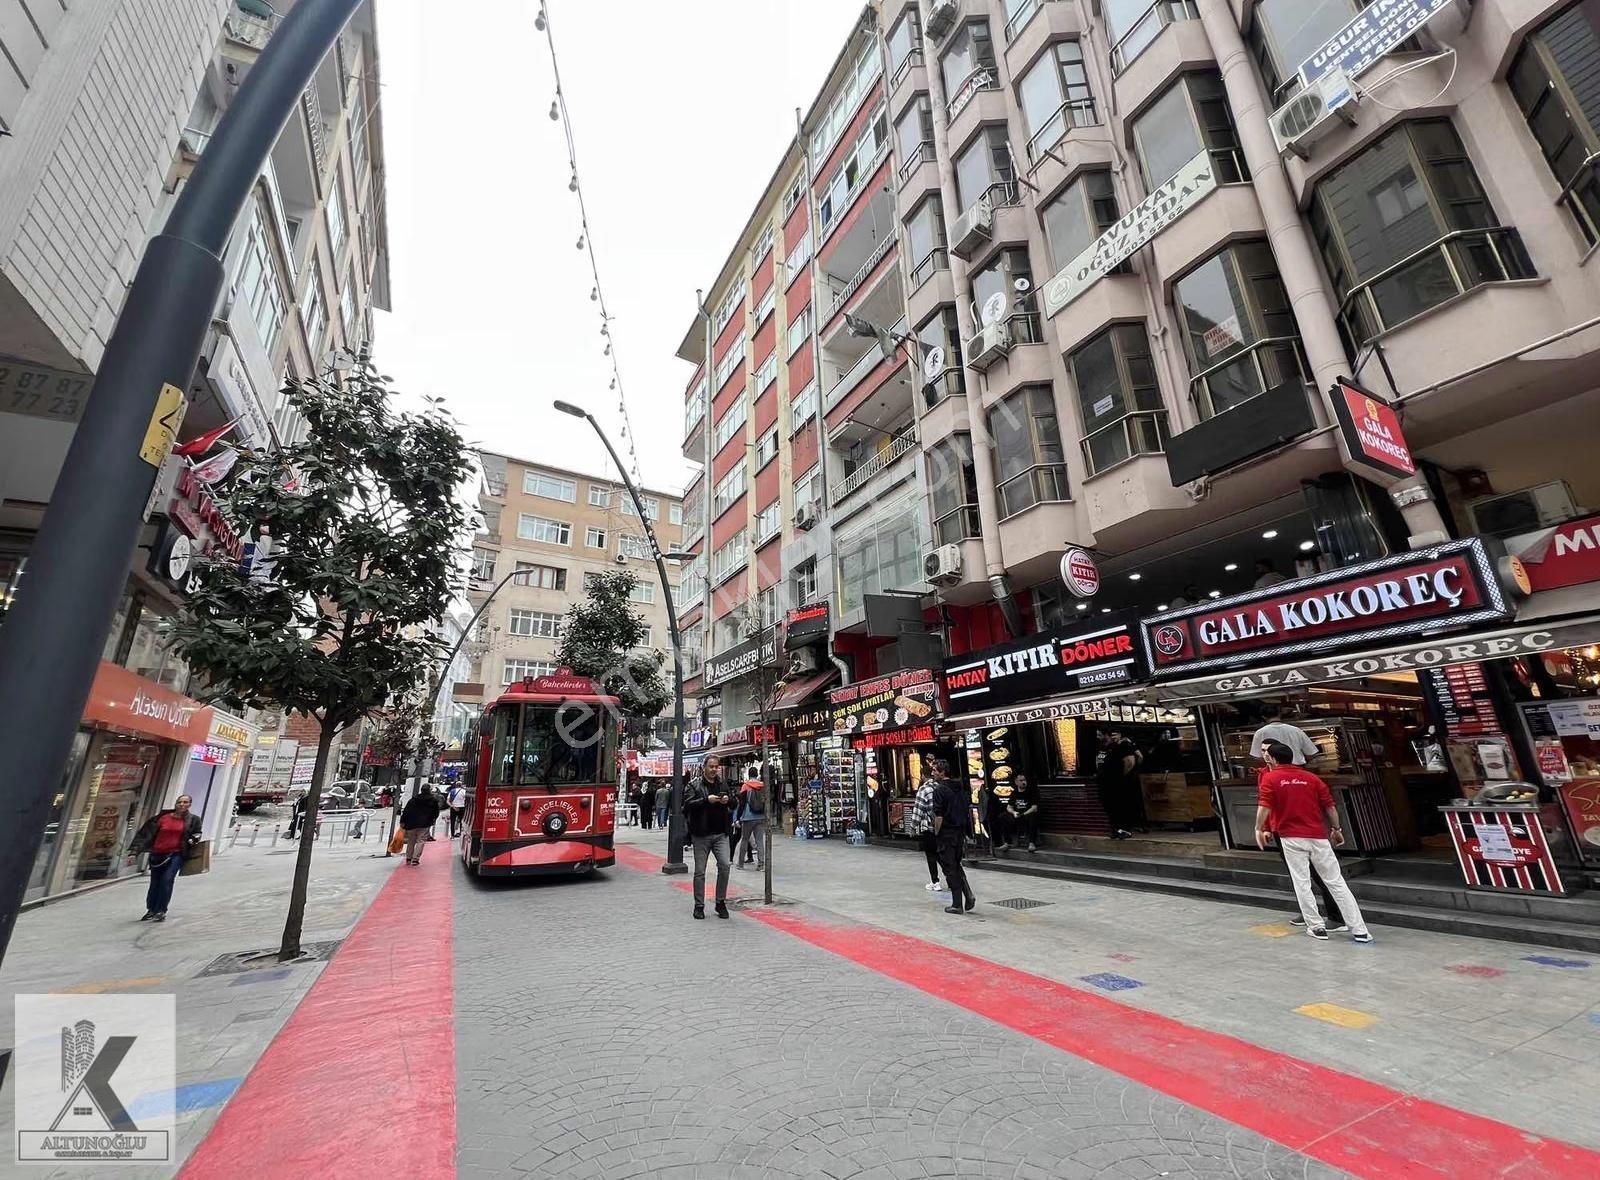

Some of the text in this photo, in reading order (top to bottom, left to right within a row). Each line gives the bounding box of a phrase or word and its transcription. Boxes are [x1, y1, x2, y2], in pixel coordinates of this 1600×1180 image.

[1406, 10, 1429, 29] 03
[1076, 167, 1211, 282] OĞUZ FİDAN
[1095, 174, 1180, 252] AVUKAT
[1101, 205, 1185, 274] Tel: 603 52 62
[1363, 416, 1394, 441] GALA
[1358, 428, 1410, 465] KOKOREÇ
[1071, 565, 1096, 579] KITIR
[1200, 566, 1463, 646] GALA KOKOREÇ
[947, 634, 1134, 689] HATAY KITIR DÖNER
[1079, 670, 1125, 685] 0212 452 54 54
[1215, 670, 1308, 692] GALA
[862, 690, 895, 709] FİYATLAR
[985, 712, 1019, 727] HATAY
